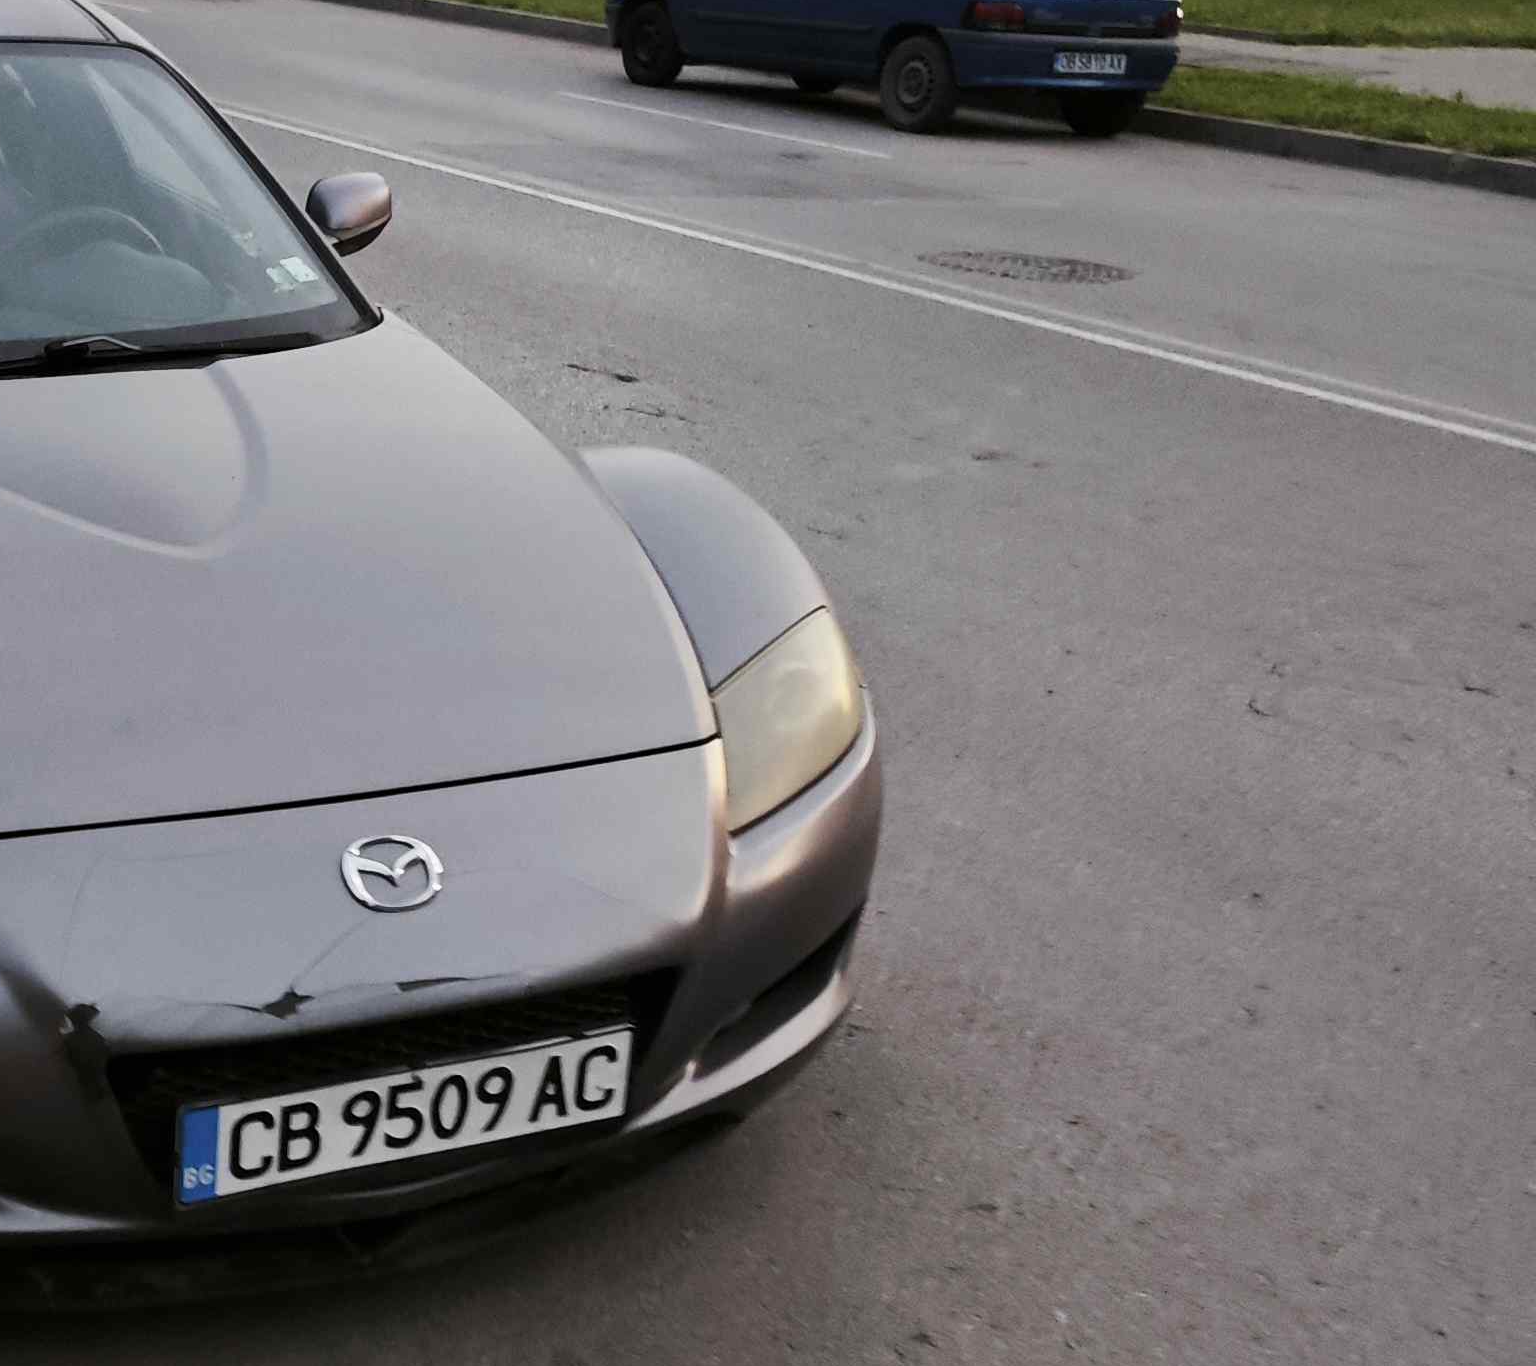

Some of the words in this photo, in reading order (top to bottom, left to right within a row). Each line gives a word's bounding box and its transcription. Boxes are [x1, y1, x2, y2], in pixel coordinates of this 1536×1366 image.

[228, 1101, 321, 1180] CB
[342, 1066, 513, 1156] 9509
[528, 1045, 618, 1123] AC
[183, 1164, 214, 1189] BG
